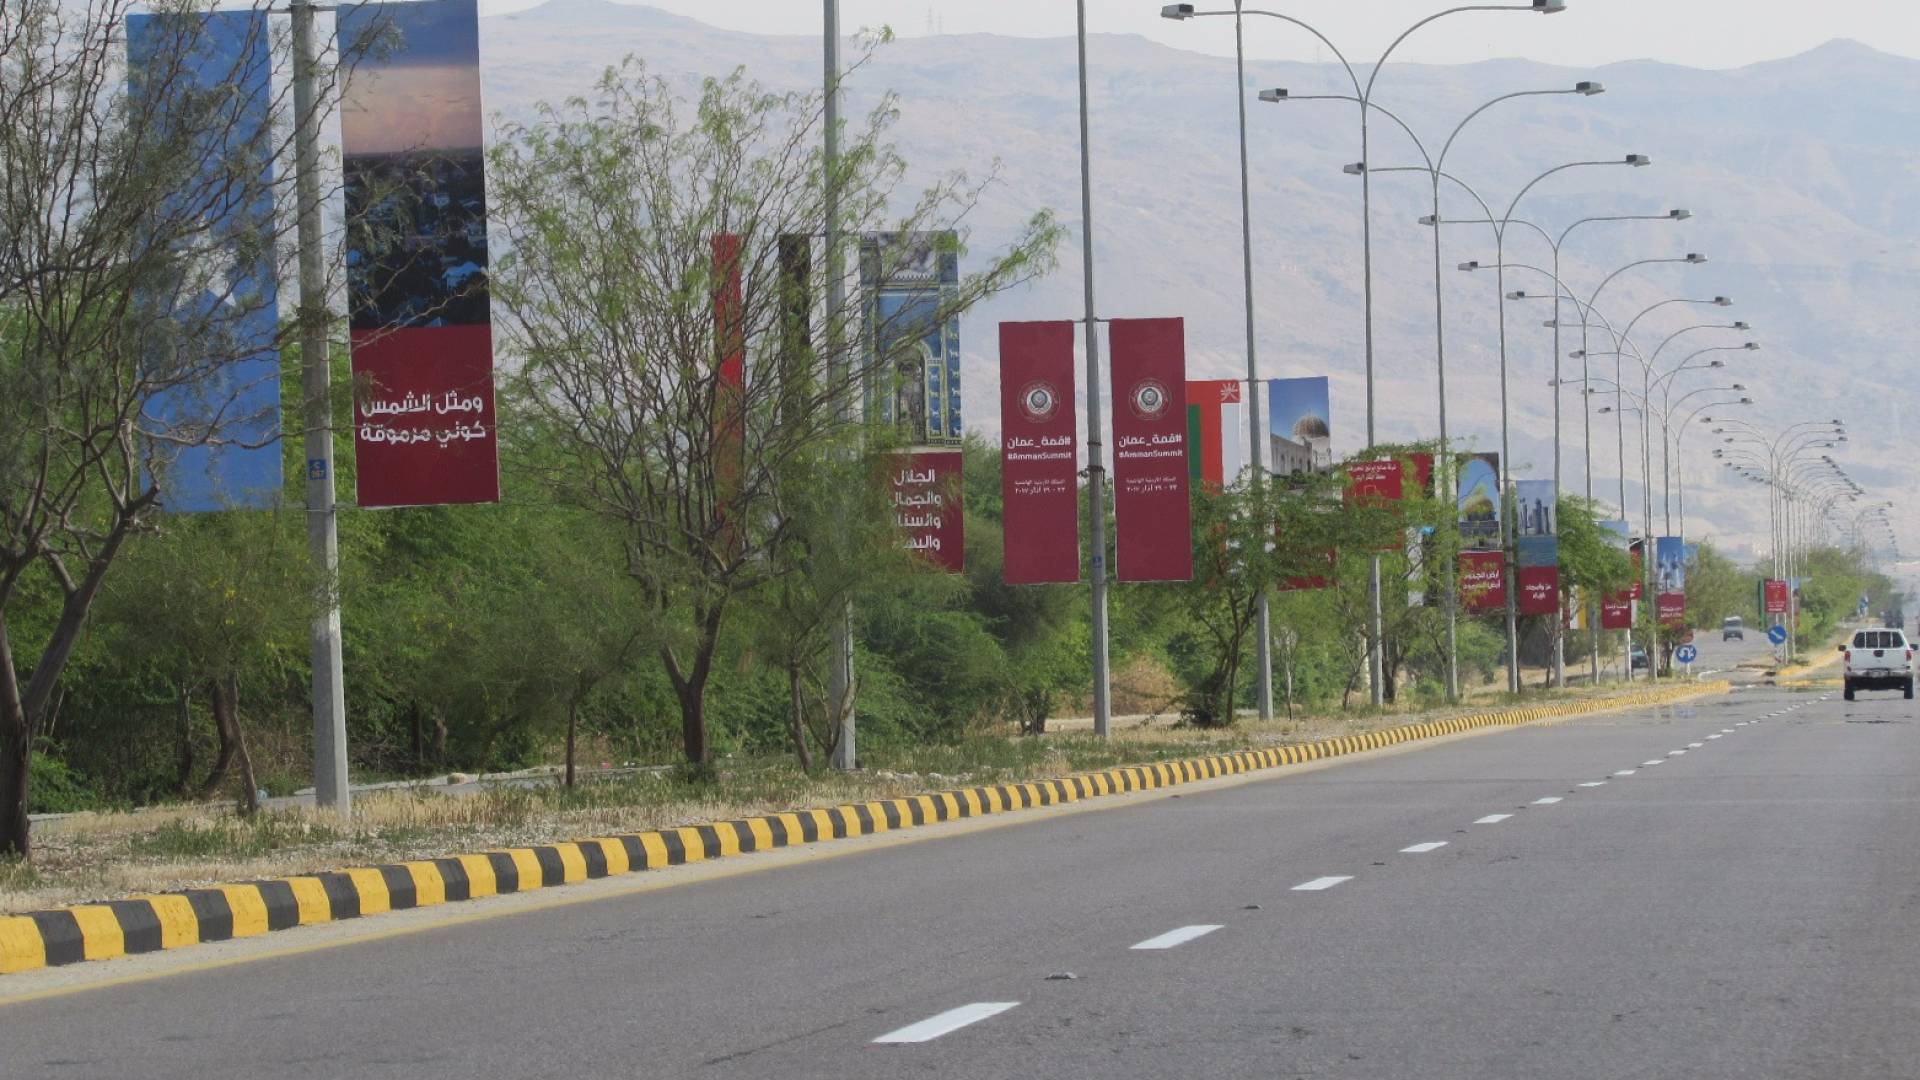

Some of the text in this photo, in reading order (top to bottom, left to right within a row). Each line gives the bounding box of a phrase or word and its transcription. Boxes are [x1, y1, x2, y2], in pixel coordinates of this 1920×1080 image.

[361, 390, 483, 417] ومثل الشمس
[436, 421, 486, 448] كوني
[1008, 451, 1072, 460] #AmmanSummit
[1119, 449, 1183, 458] #AmmanSummit
[893, 469, 936, 486] الجلال
